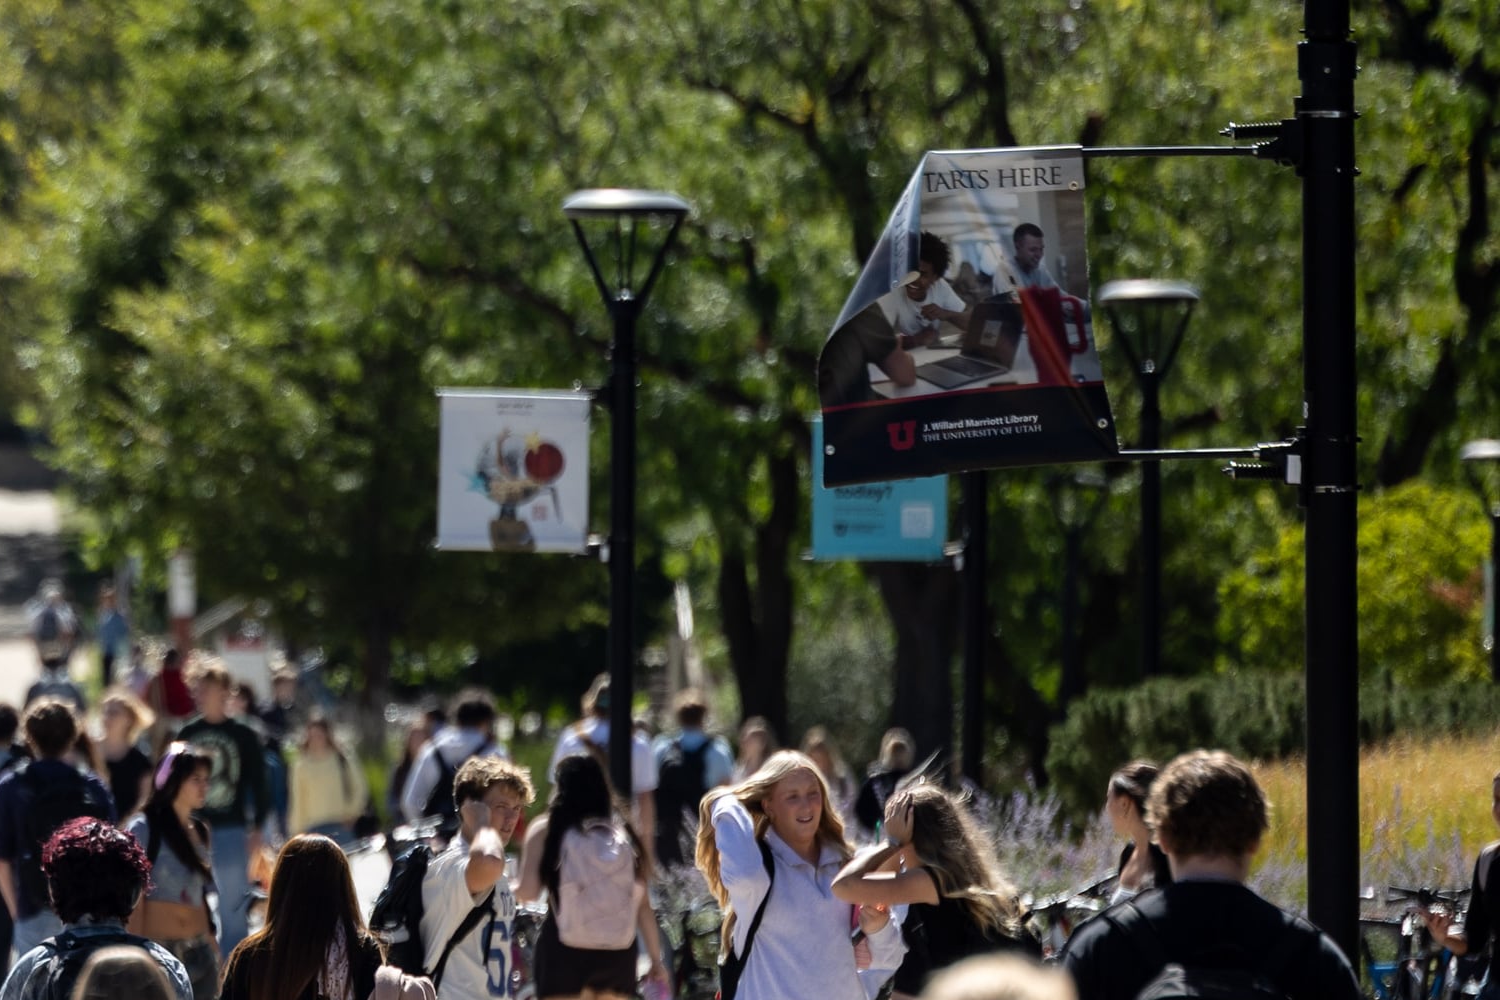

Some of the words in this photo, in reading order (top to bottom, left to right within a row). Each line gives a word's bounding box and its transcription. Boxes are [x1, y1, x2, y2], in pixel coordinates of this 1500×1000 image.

[997, 166, 1062, 188] HERE
[922, 432, 940, 442] THE
[943, 428, 999, 440] UNIVERSITY
[1000, 426, 1013, 435] OF
[1015, 424, 1042, 434] UTAH
[923, 424, 931, 432] J.
[931, 419, 964, 431] Willard
[965, 416, 1004, 429] Marriott
[1005, 414, 1038, 425] Library
[887, 420, 917, 451] U
